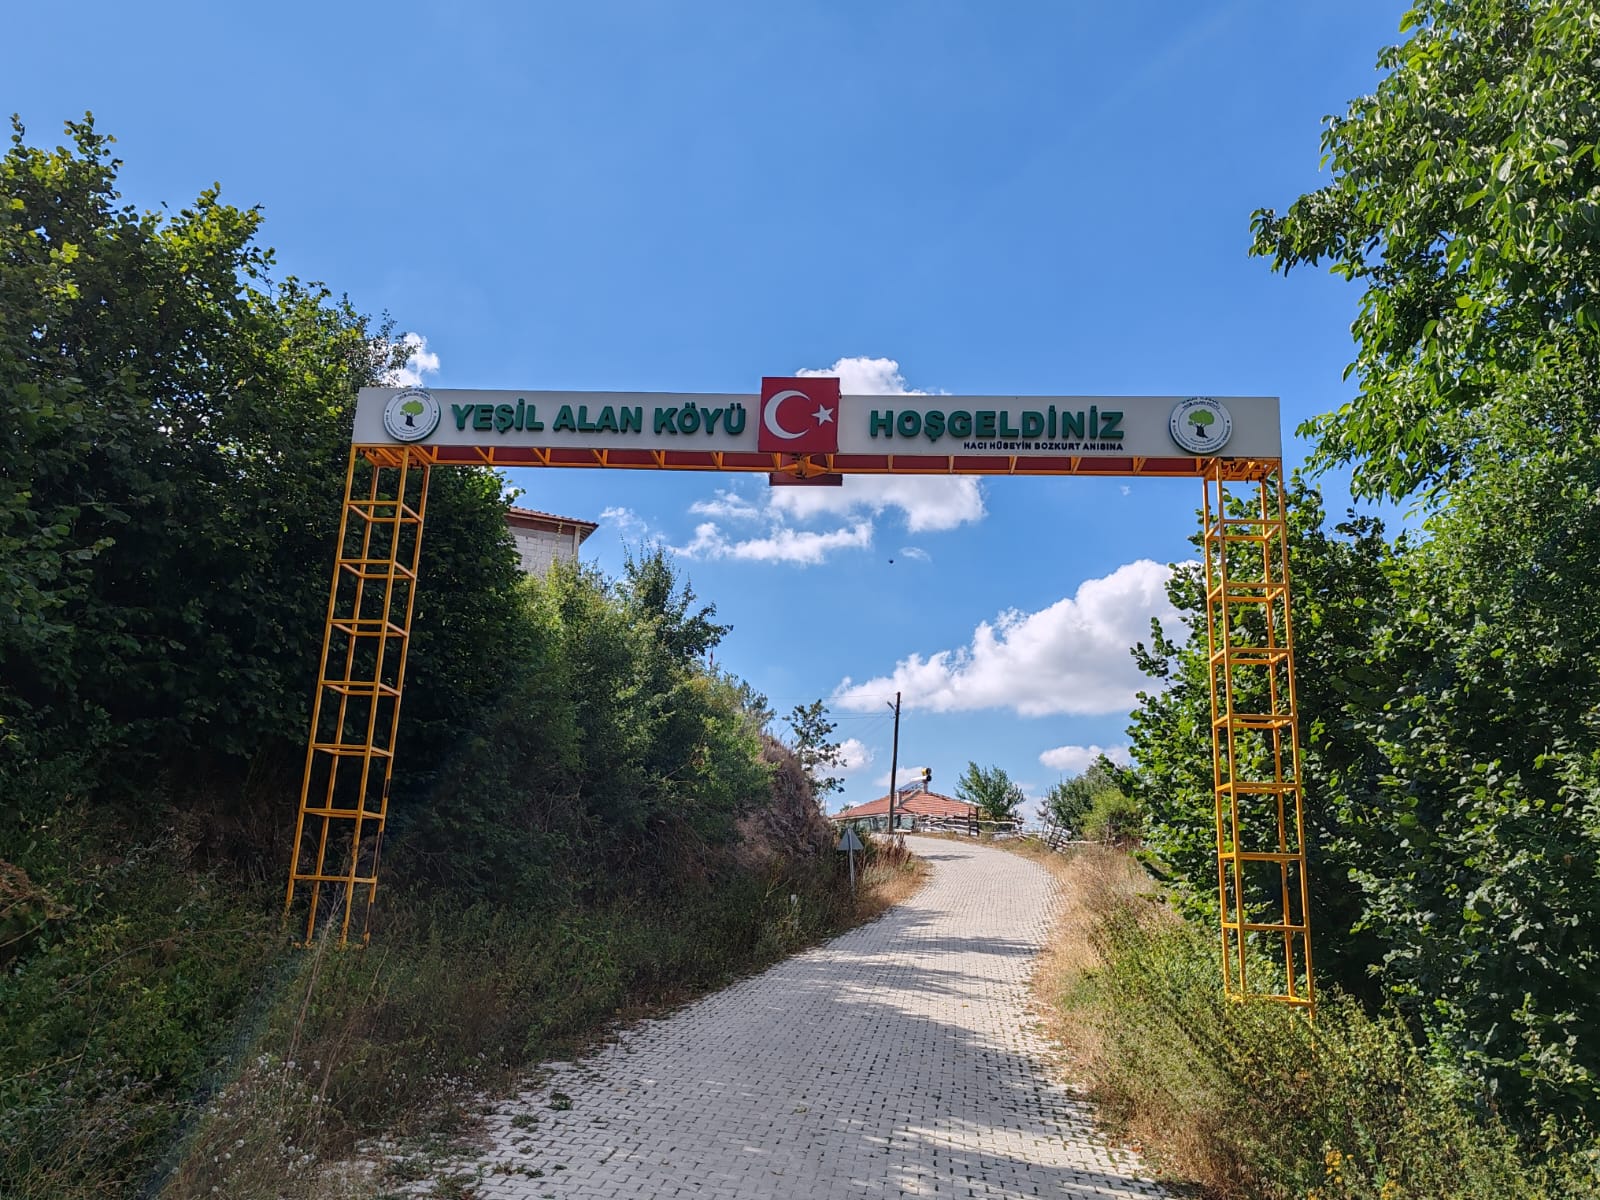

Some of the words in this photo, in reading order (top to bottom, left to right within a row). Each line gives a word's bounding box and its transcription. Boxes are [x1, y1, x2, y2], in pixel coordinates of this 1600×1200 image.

[451, 398, 544, 433] YEŞİL
[552, 404, 643, 433] ALAN
[653, 402, 746, 435] KÖYÜ
[870, 405, 1125, 442] HOŞGELDİNİZ
[963, 441, 987, 450] HACI
[990, 440, 1032, 450] HÜSEYİN
[1034, 441, 1081, 451] BOZKURT
[1083, 442, 1124, 451] ANISINA
